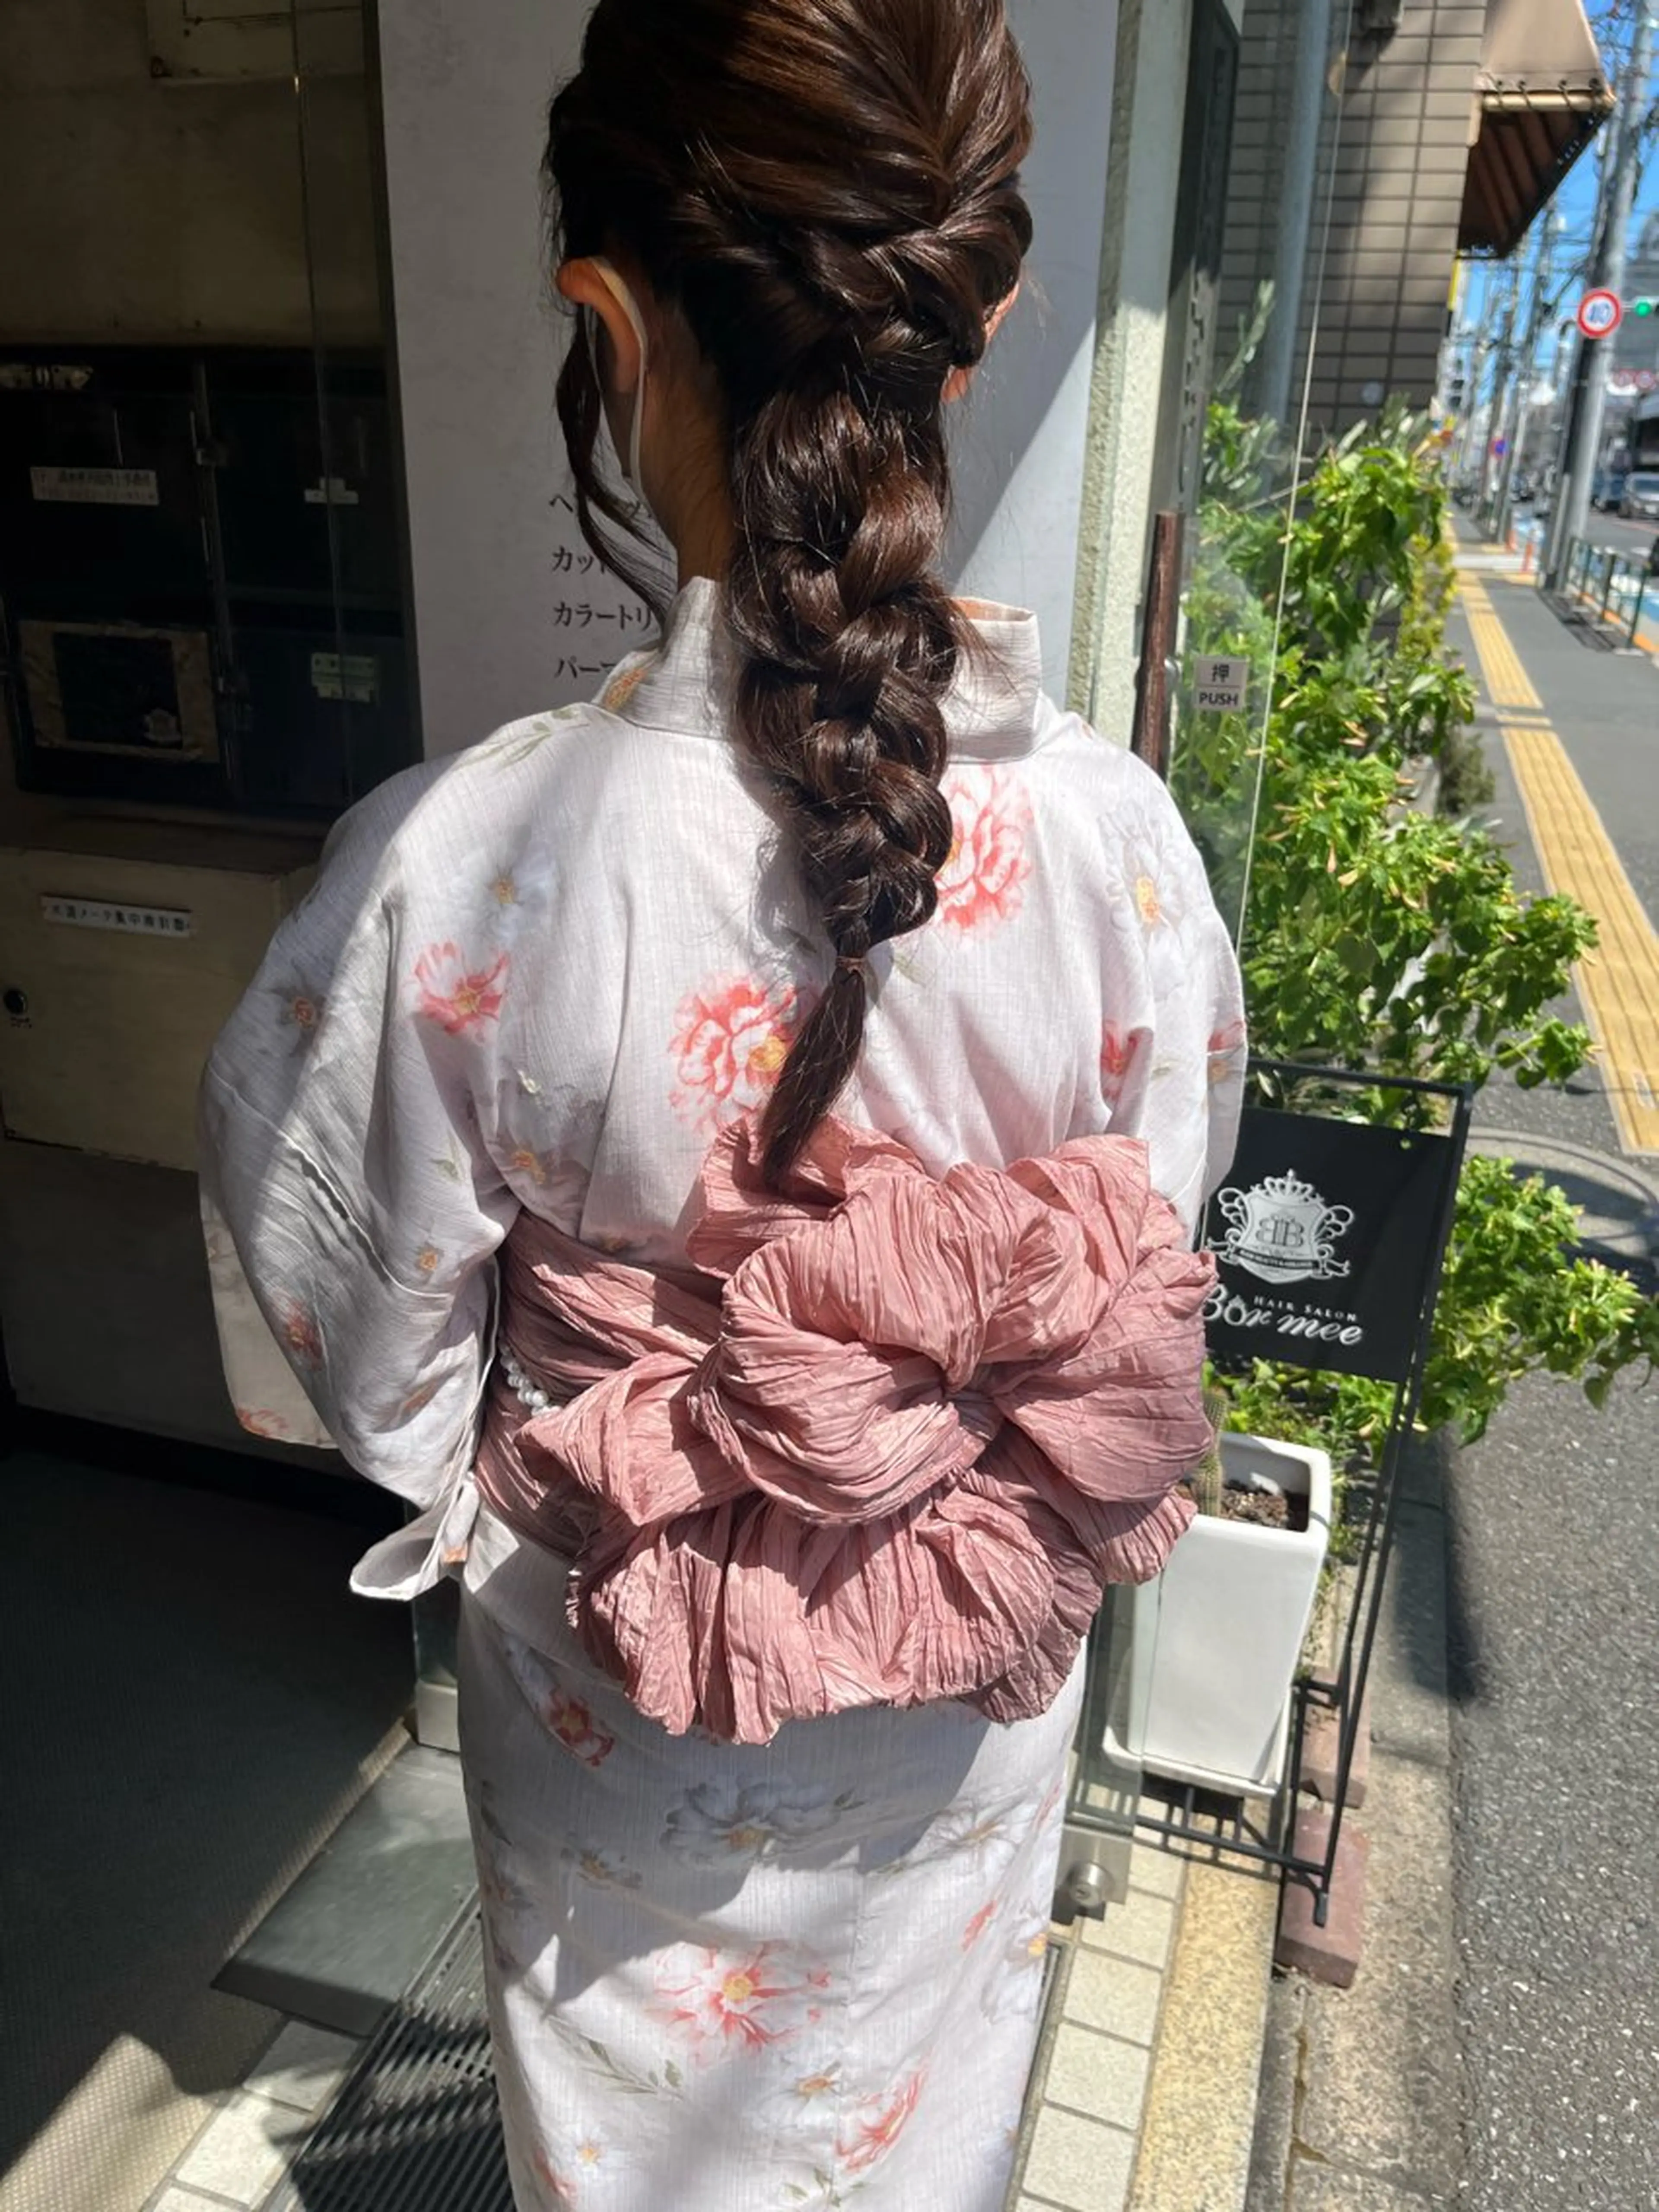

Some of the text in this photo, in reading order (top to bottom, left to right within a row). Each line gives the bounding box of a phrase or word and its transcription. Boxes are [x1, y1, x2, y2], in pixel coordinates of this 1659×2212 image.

[1211, 664, 1230, 683] 押
[1199, 692, 1239, 706] PUSH
[1254, 1295, 1357, 1322] HAIR SALON
